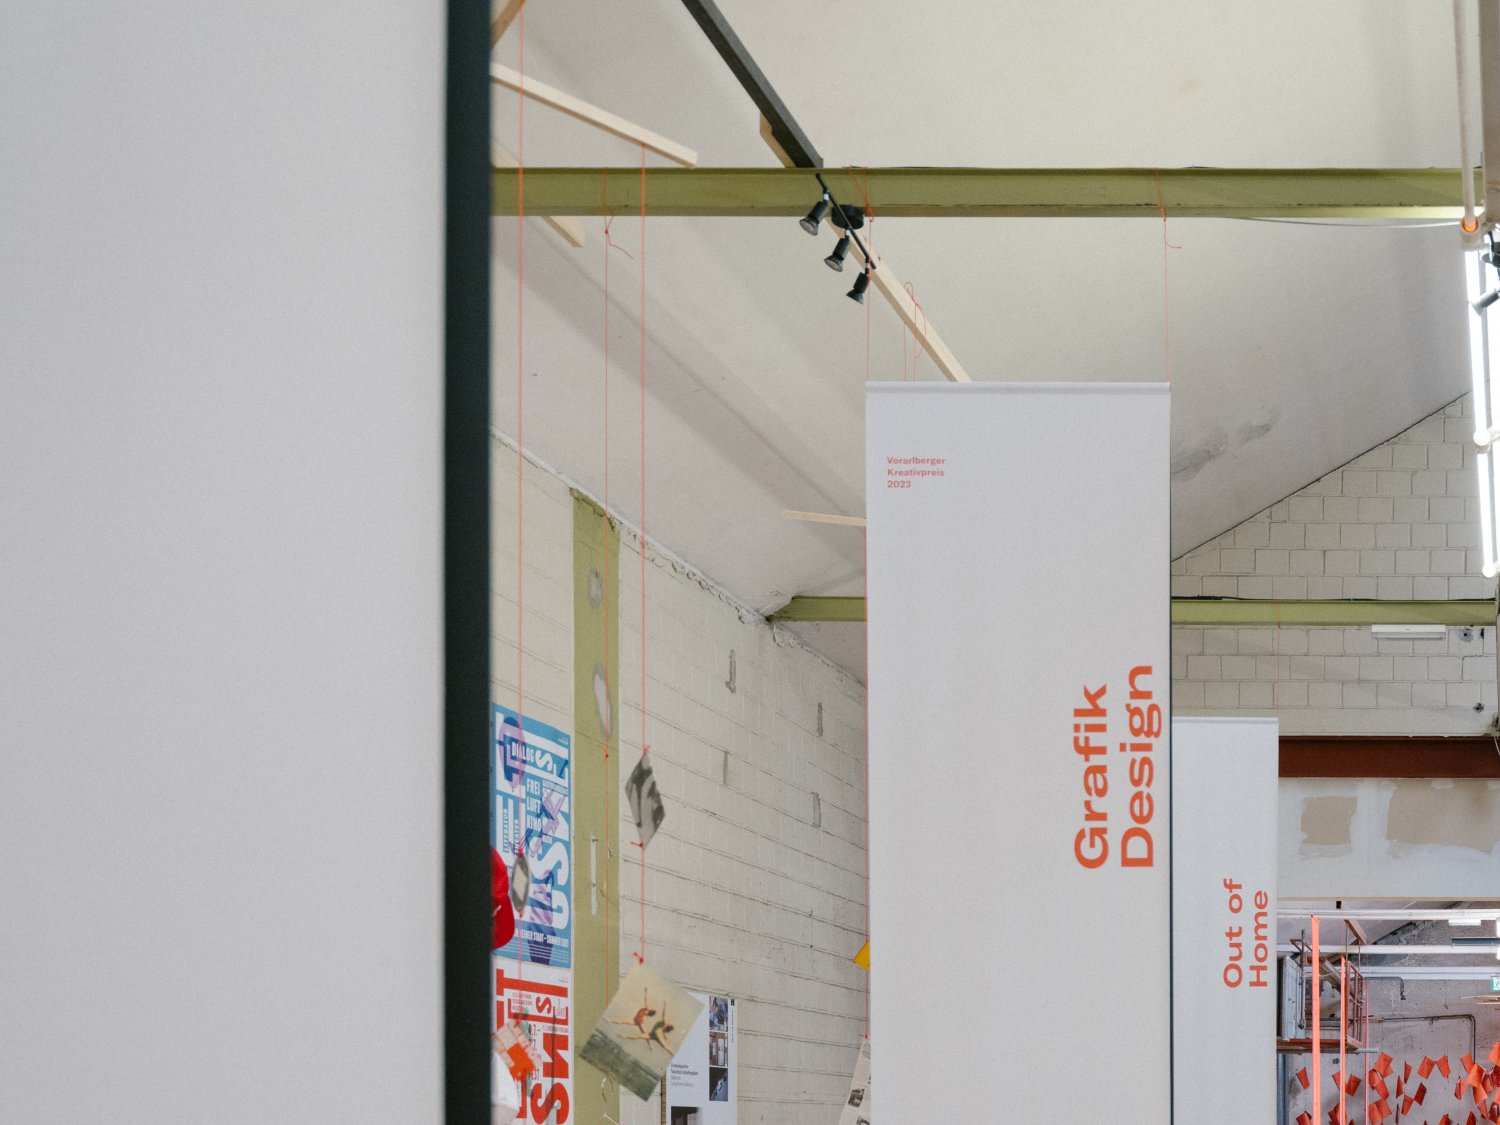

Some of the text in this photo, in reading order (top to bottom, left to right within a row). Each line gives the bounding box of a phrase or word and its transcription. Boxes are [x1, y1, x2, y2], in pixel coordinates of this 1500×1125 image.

[887, 457, 945, 466] Vorarlberger
[887, 467, 945, 477] Kreativpreis
[1073, 684, 1109, 869] Grafik
[1119, 666, 1162, 868] Design
[1223, 879, 1243, 988] Out of
[1249, 891, 1268, 987] Home
